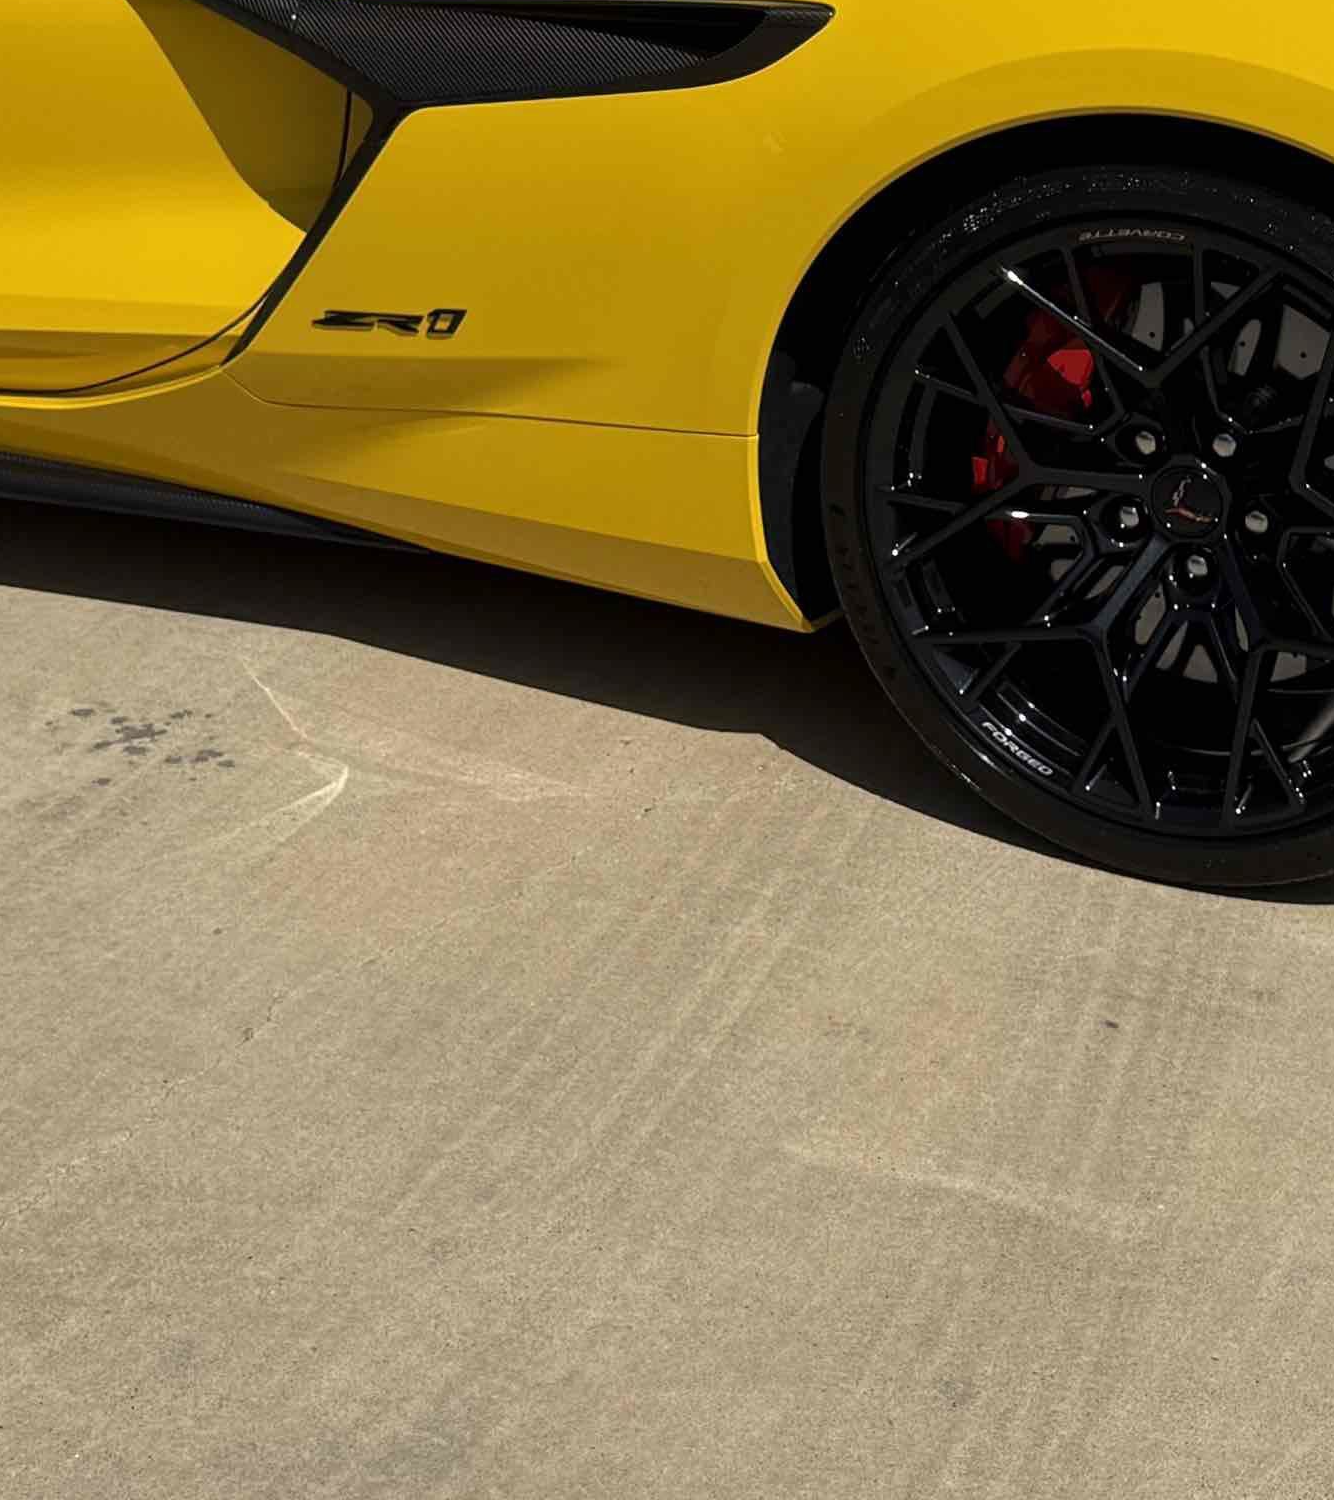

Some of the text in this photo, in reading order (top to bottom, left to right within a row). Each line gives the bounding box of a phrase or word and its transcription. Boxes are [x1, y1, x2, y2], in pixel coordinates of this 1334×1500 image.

[1077, 227, 1186, 242] CORVETTE
[311, 308, 467, 339] ZR1
[981, 721, 1054, 777] FORGED
